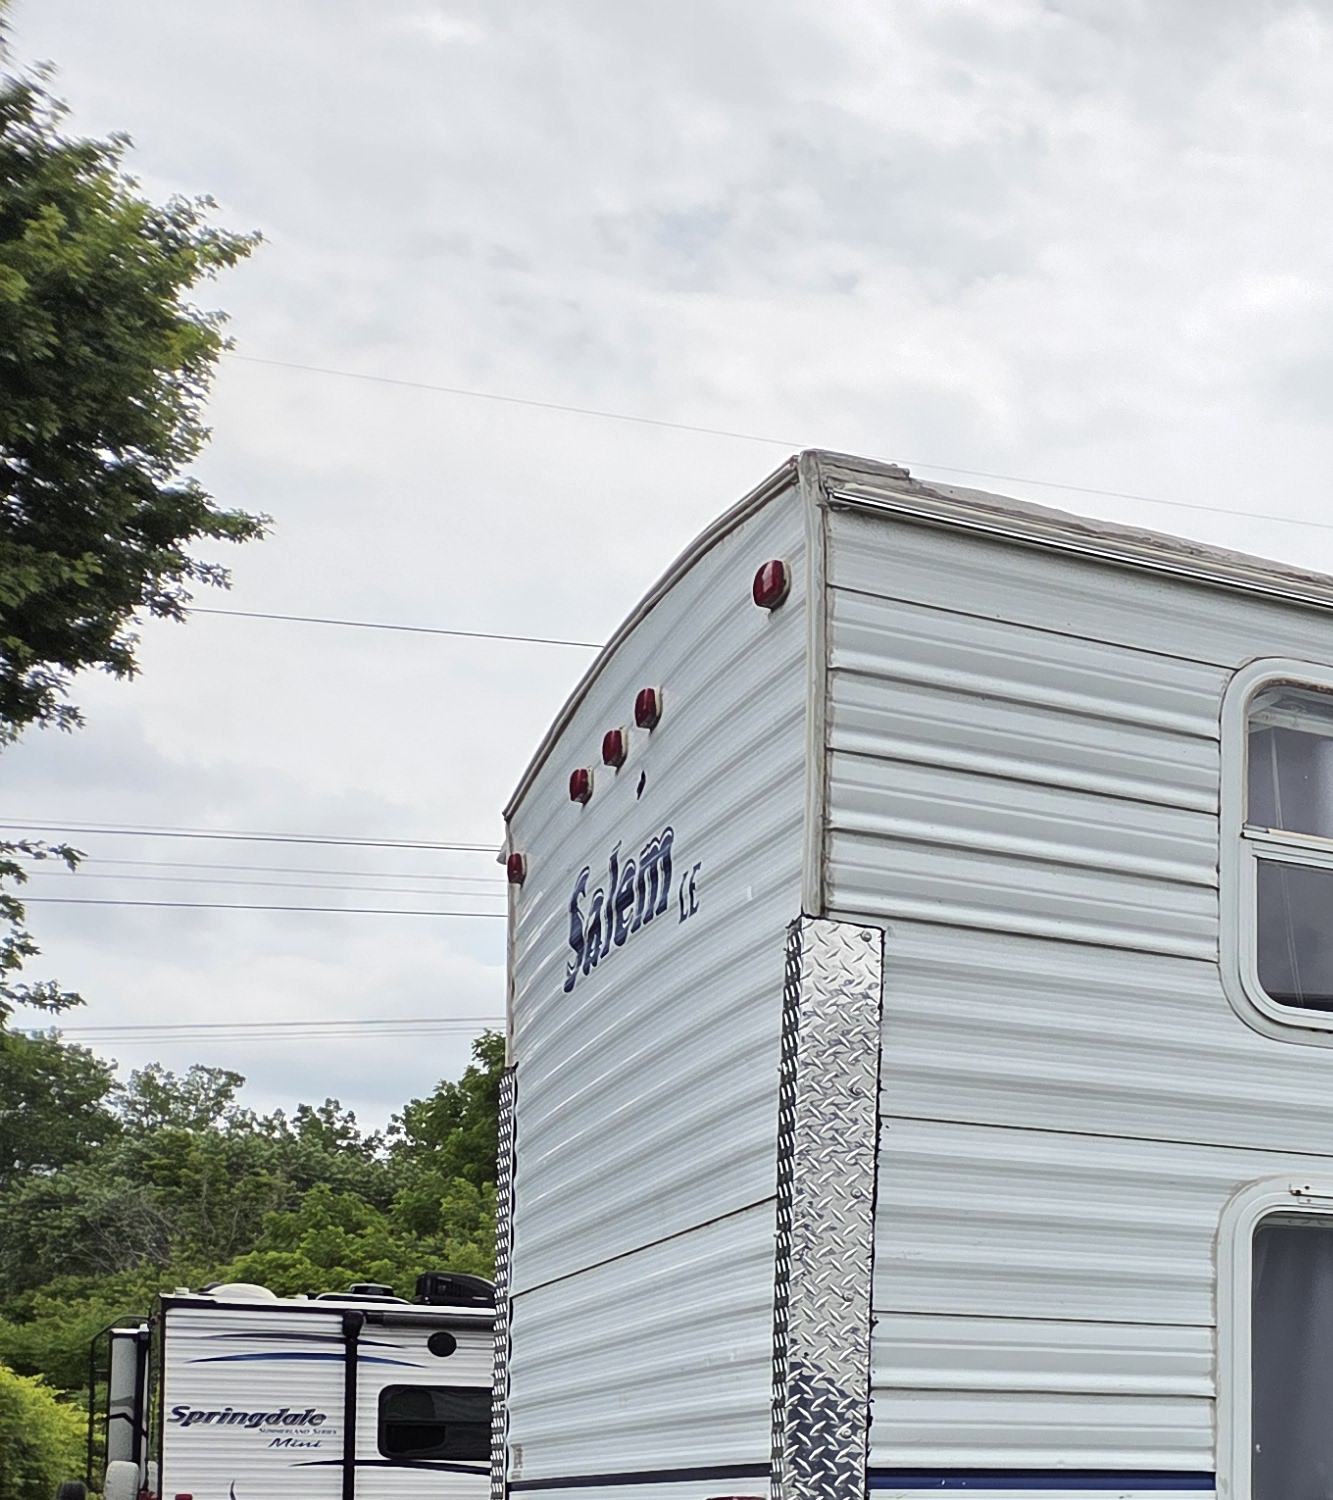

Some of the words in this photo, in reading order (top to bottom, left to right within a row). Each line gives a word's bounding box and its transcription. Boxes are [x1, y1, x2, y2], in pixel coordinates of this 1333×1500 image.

[563, 825, 675, 992] Salem
[678, 861, 702, 924] LE
[166, 1405, 328, 1429] Springdale
[267, 1437, 322, 1448] Mini
